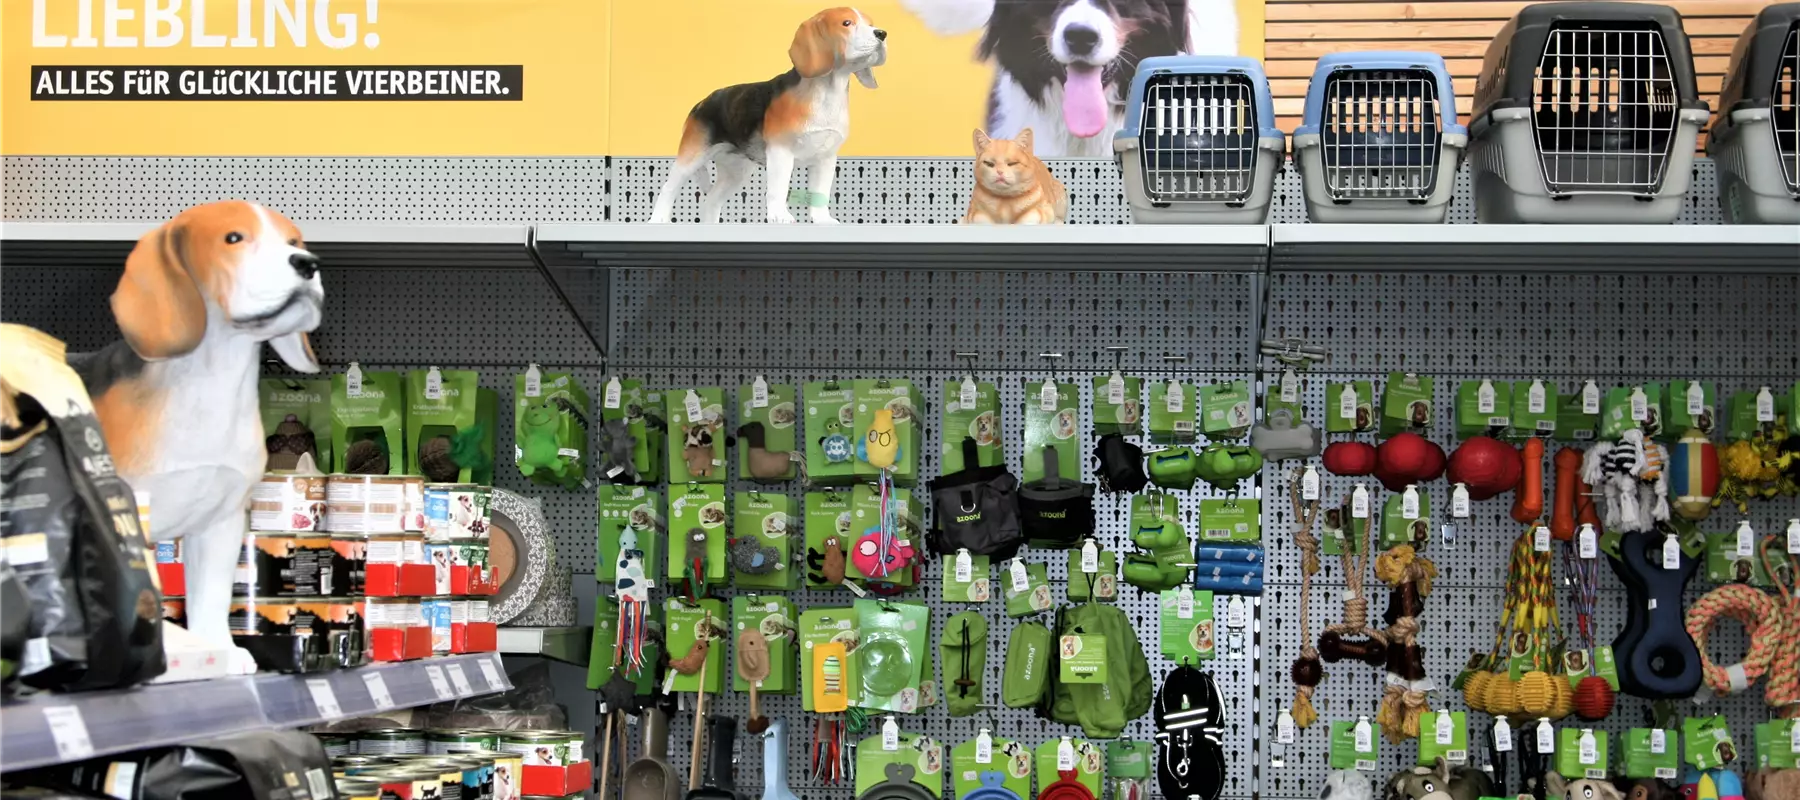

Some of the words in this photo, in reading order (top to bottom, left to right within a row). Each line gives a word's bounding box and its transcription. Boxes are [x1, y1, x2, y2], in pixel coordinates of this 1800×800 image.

[32, 0, 380, 49] LIEBLING!
[36, 70, 114, 95] ALLES
[123, 70, 170, 95] FüR
[179, 70, 337, 95] GLüCKLICHE
[346, 70, 510, 95] VIERBEINER.
[269, 392, 321, 402] azoona
[748, 501, 774, 509] azoona
[956, 512, 981, 522] azoona
